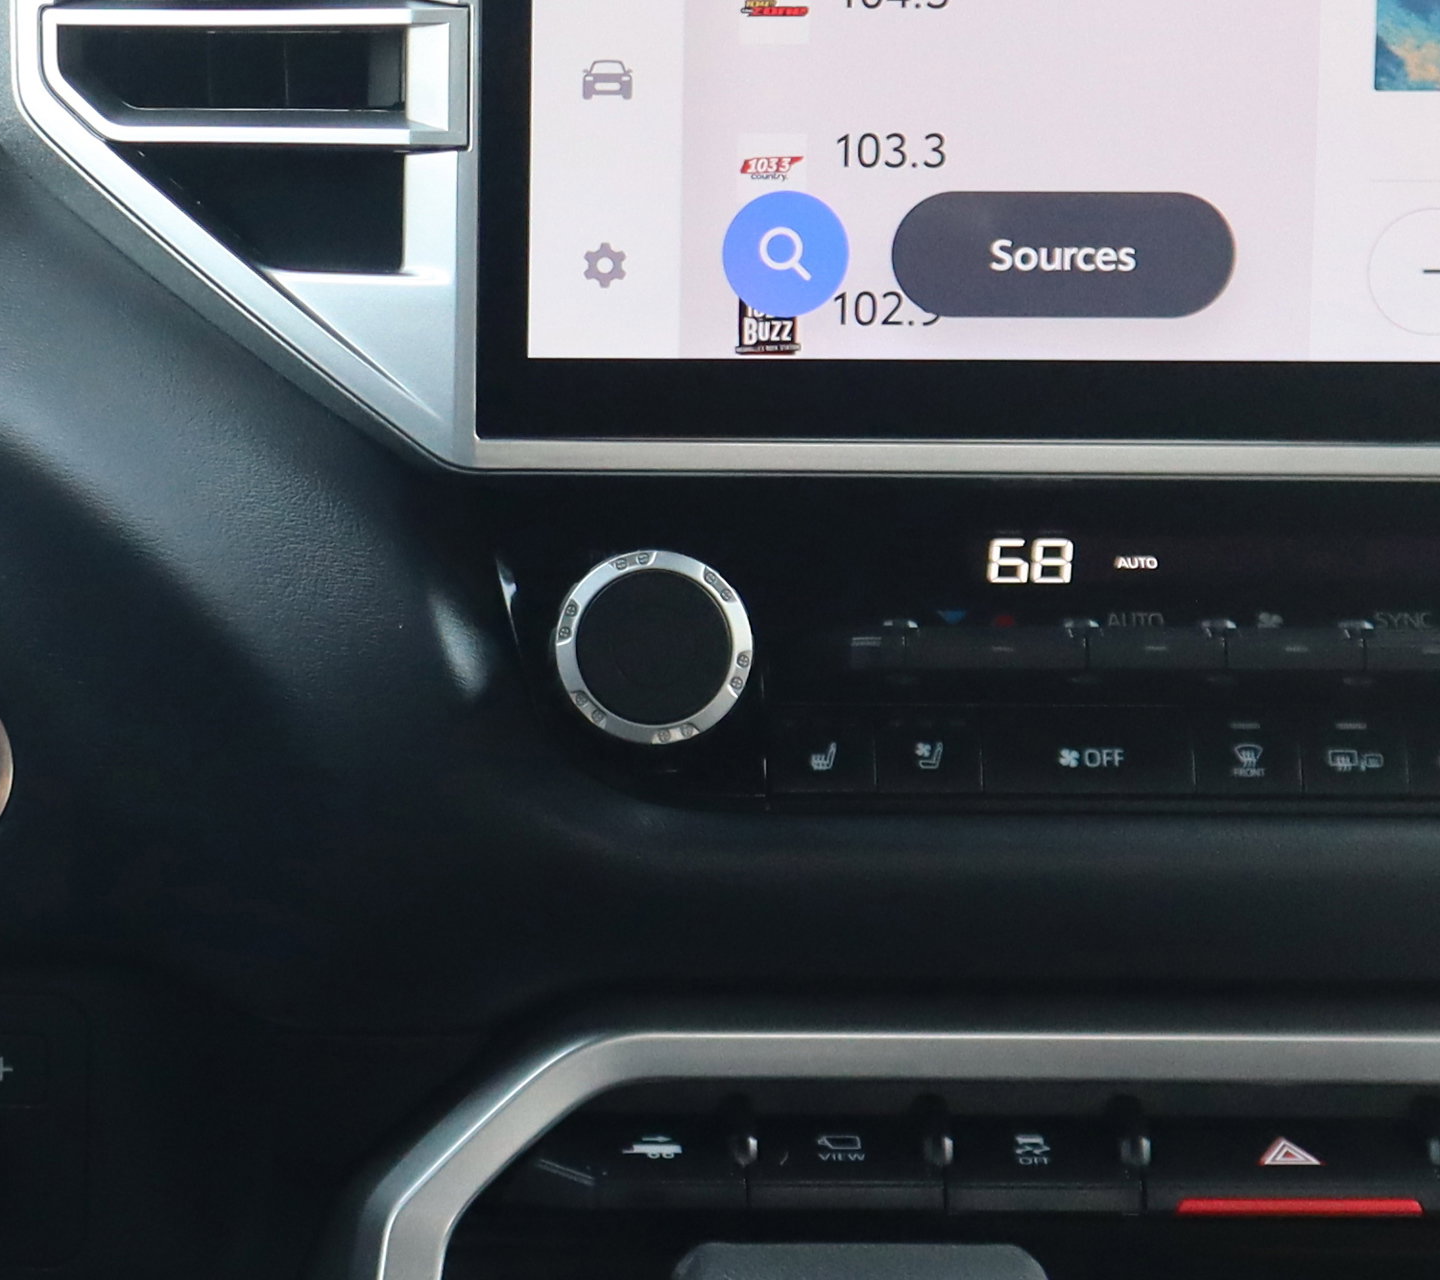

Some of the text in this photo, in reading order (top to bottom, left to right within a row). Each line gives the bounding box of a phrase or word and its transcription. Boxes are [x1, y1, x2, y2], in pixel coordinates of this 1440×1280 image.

[836, 132, 947, 169] 103.3
[989, 239, 1138, 275] Sources
[985, 537, 1074, 585] 68
[1115, 555, 1160, 570] AUTO
[1083, 747, 1126, 768] OFF
